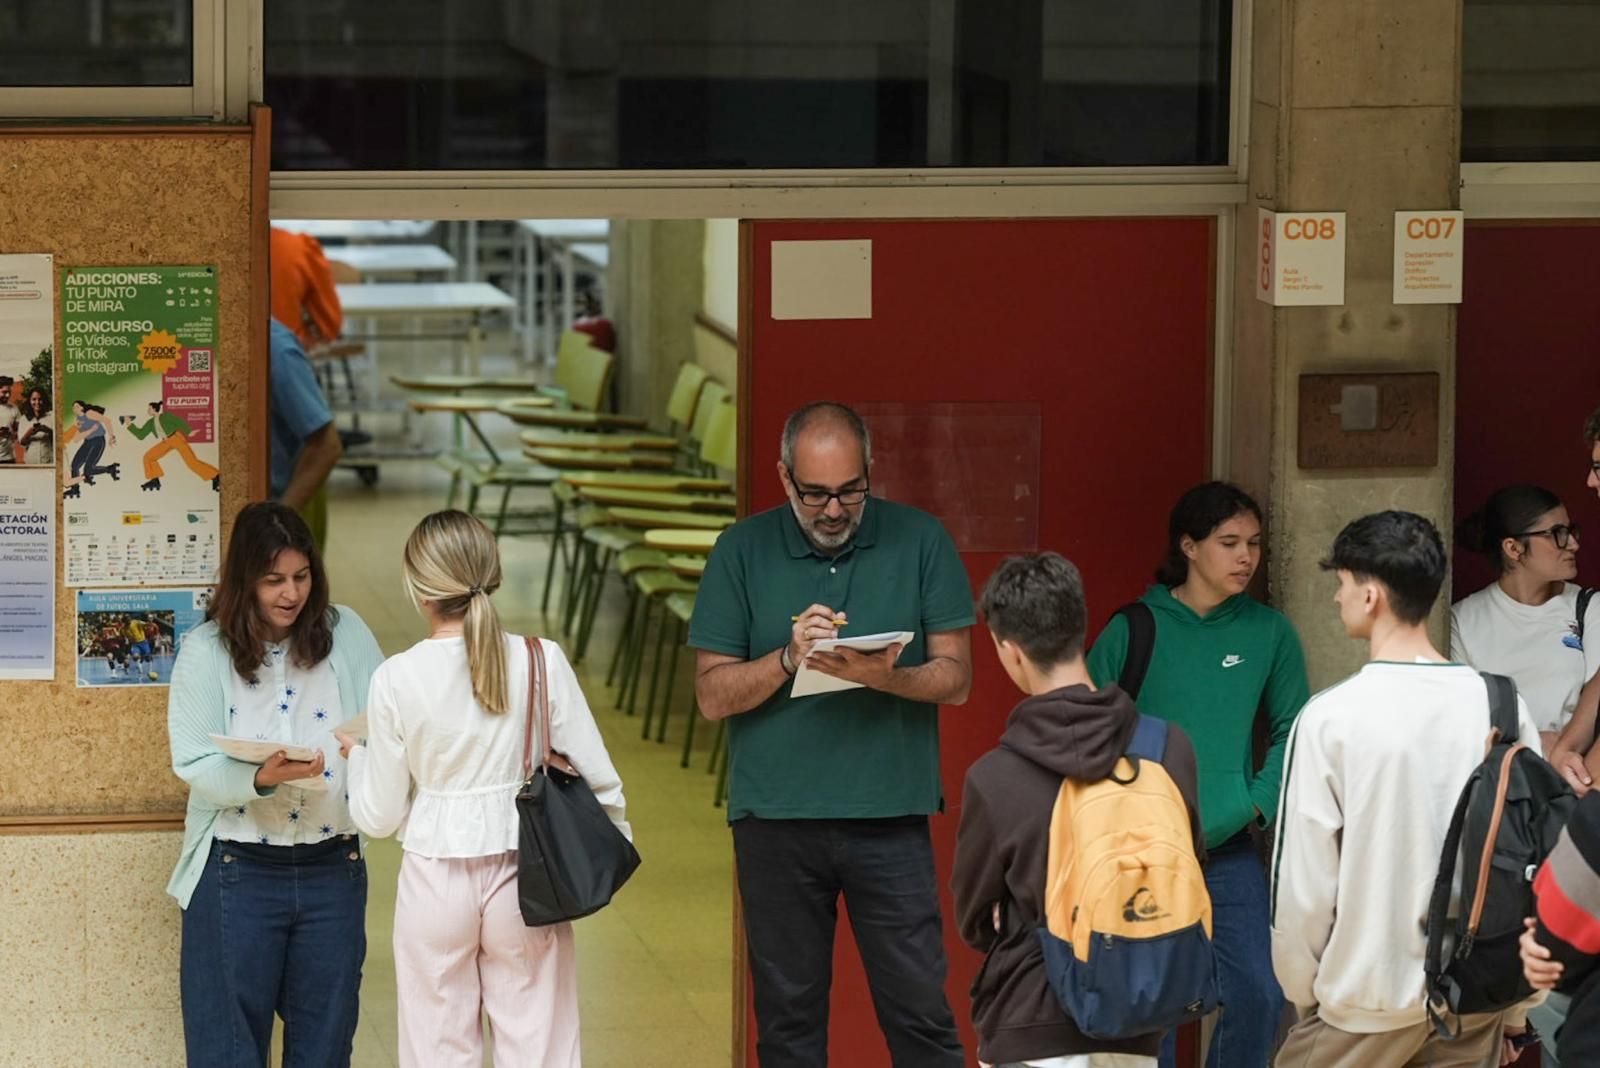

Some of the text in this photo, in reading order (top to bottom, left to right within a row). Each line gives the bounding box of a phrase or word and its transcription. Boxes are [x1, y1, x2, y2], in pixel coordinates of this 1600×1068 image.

[1283, 218, 1336, 241] C08
[1407, 217, 1457, 240] C07
[1261, 217, 1271, 291] C08
[65, 273, 162, 286] ADICCIONES:
[66, 286, 137, 299] TU PUNTO
[66, 300, 125, 312] DE MIRA
[66, 320, 154, 333] CONCURSO
[66, 334, 82, 346] de
[66, 347, 108, 360] TikTok
[143, 346, 177, 356] 7.500€
[66, 361, 139, 375] e Instagram
